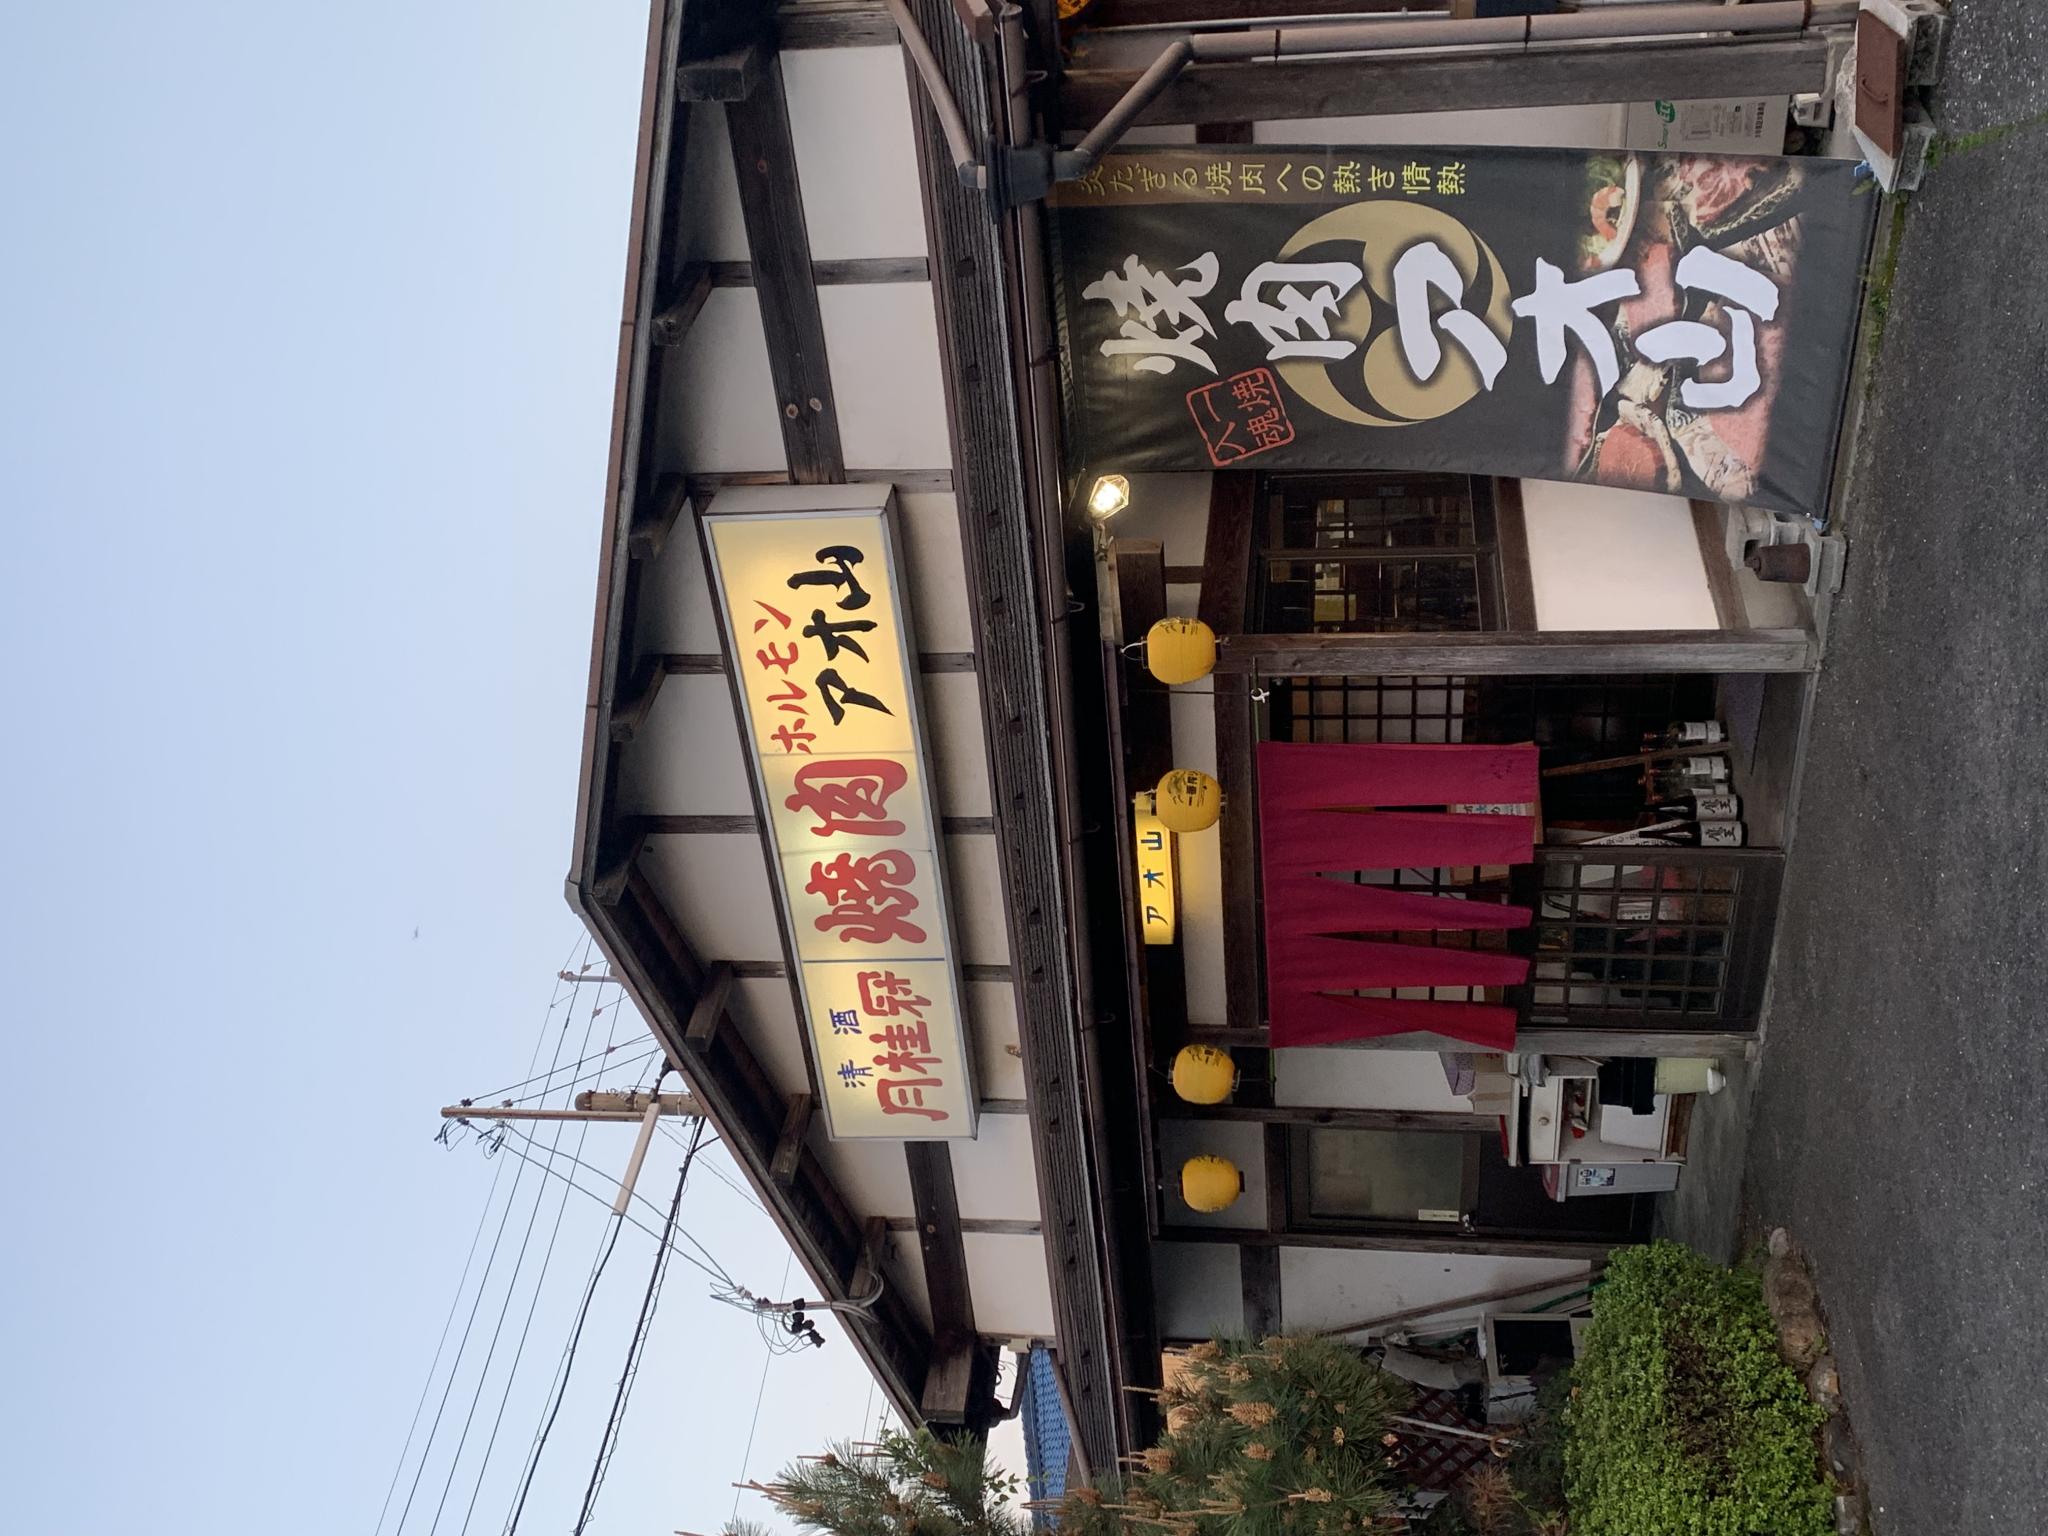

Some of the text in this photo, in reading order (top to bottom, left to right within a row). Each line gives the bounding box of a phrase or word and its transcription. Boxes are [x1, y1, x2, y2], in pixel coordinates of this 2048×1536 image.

[753, 598, 817, 755] ホルモン
[786, 545, 895, 726] アオ山
[784, 758, 927, 944] 焼肉
[1142, 831, 1168, 925] アオ山
[827, 1008, 873, 1089] 清酒
[857, 970, 950, 1121] 月桂冠
